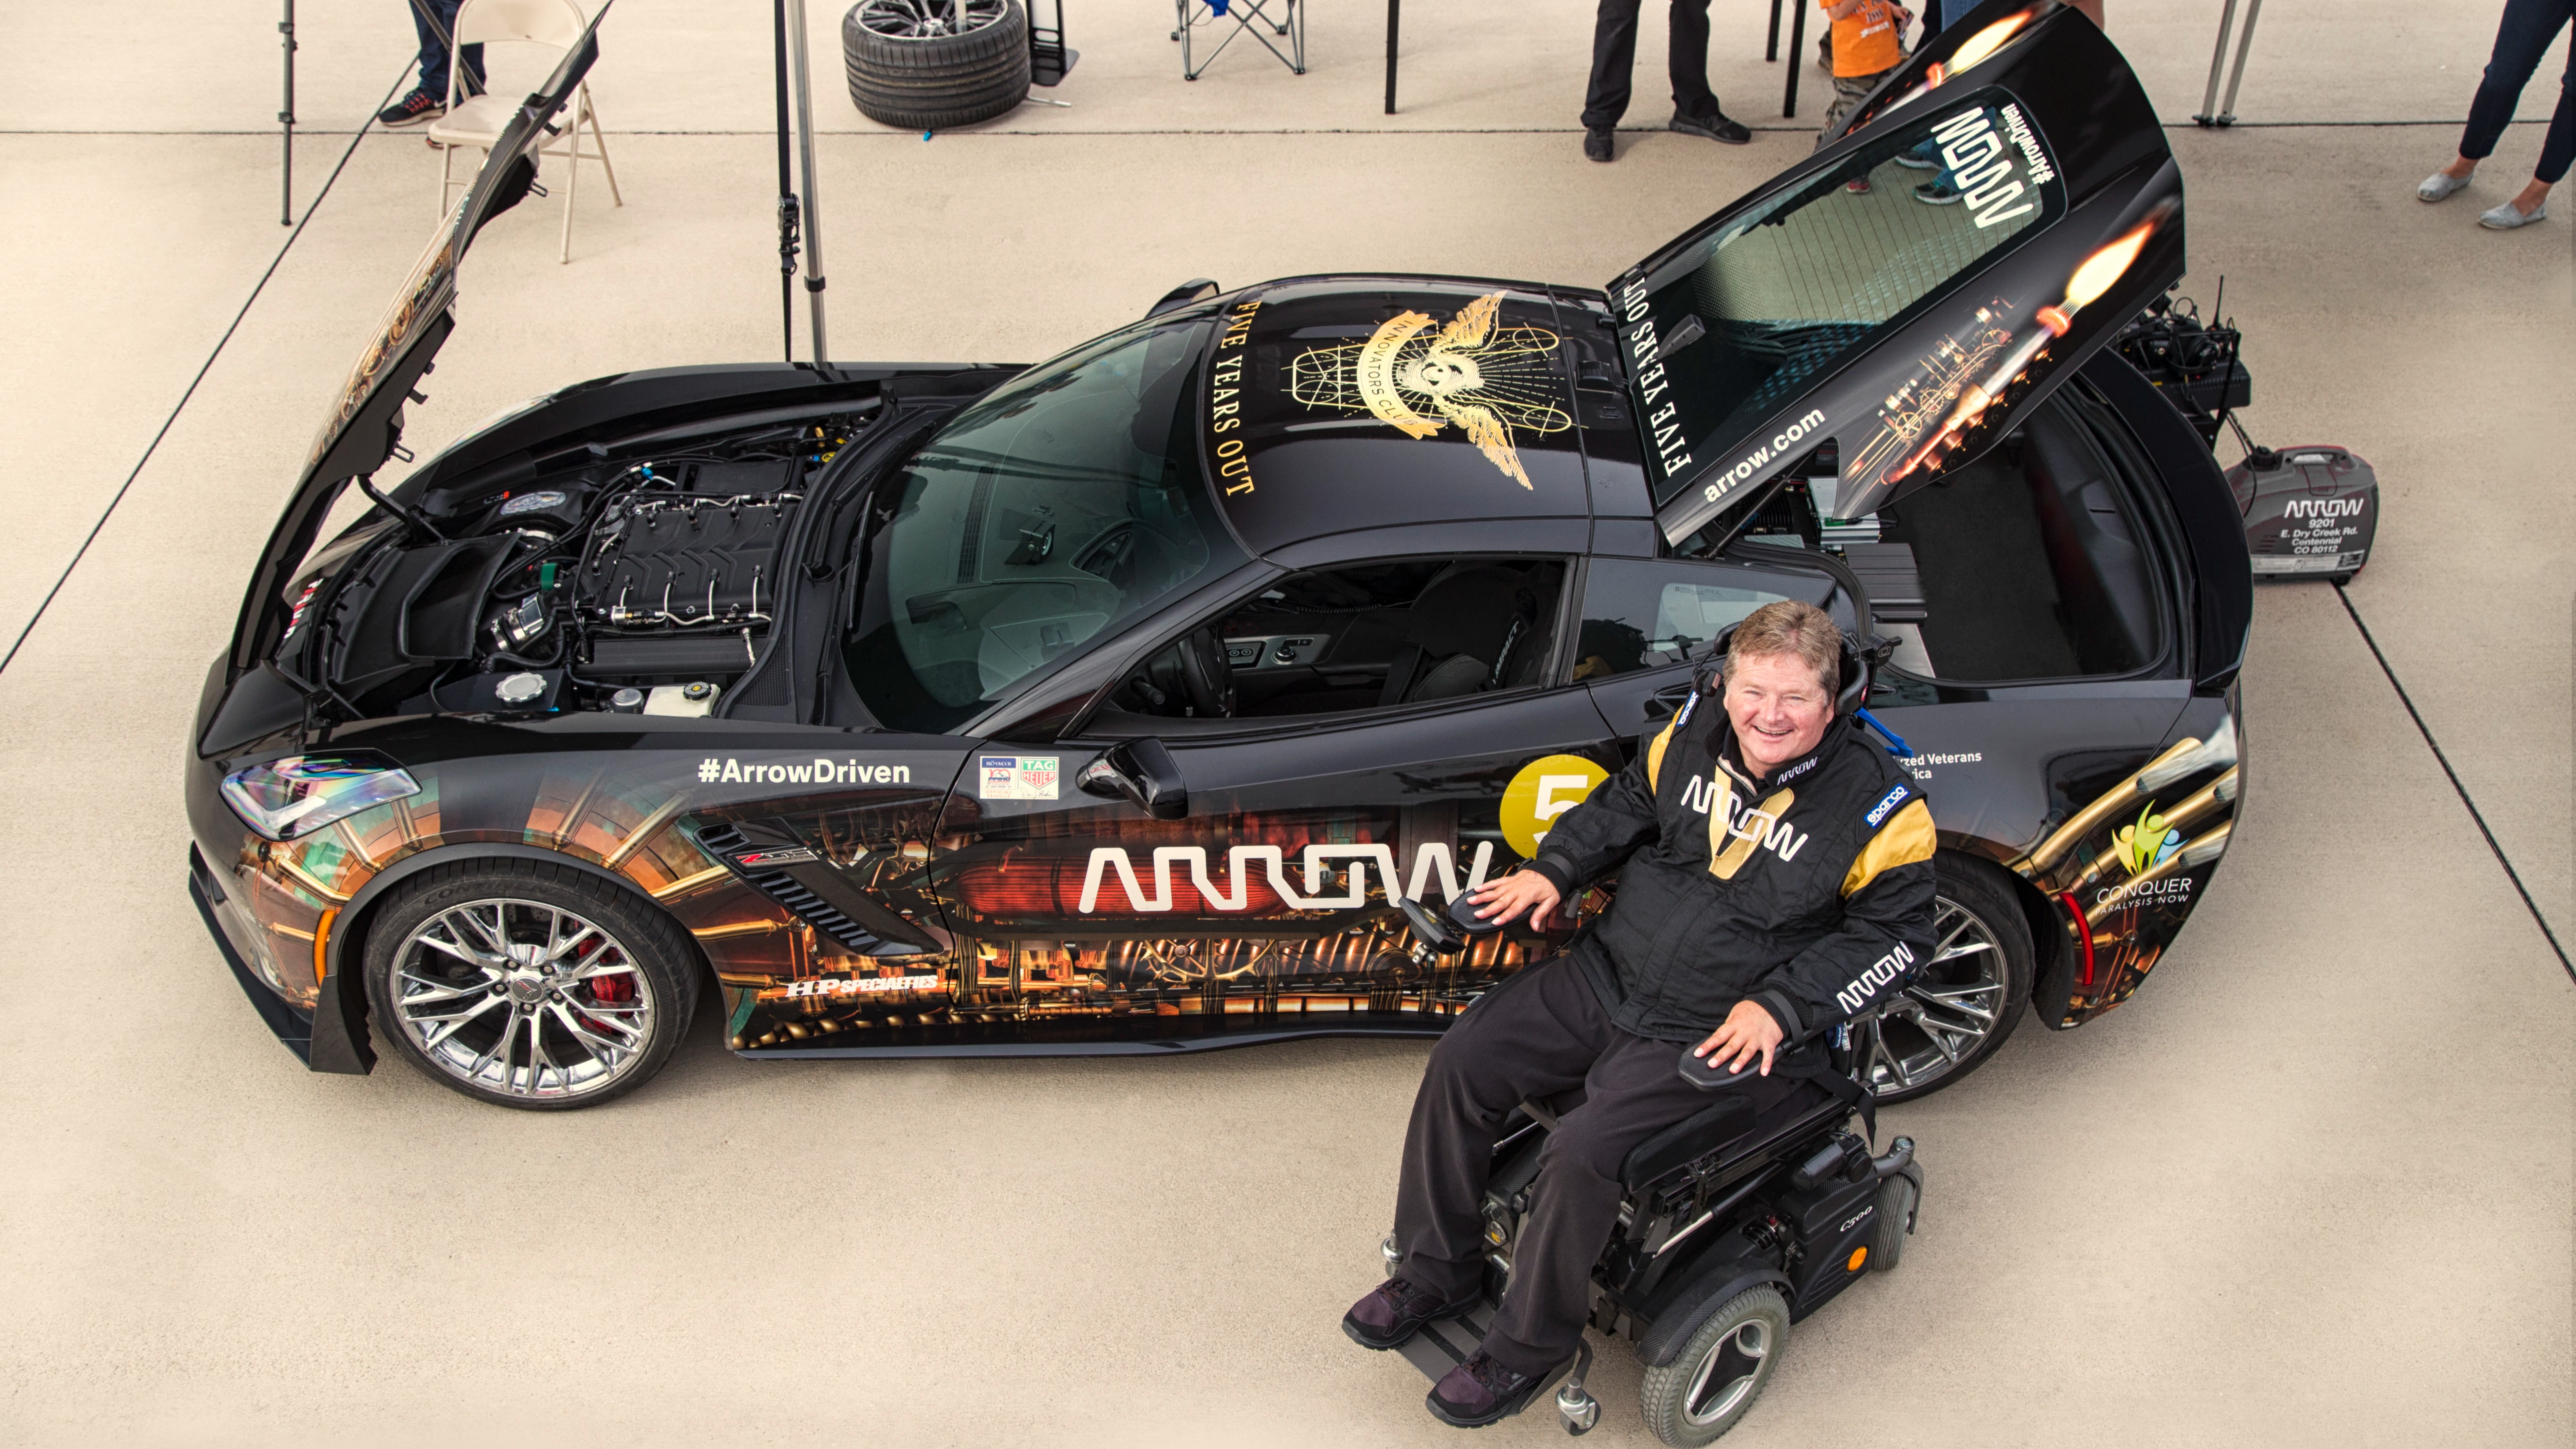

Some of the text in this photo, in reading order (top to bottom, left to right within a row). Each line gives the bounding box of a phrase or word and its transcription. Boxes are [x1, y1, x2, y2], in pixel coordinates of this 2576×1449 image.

[2001, 103, 2055, 185] #ArrowDriven
[1931, 107, 2034, 229] ARROW
[1368, 320, 1417, 426] INNOVATORS CLUB
[1624, 278, 1691, 476] FIVE YEARS OUT
[1213, 300, 1262, 497] FIVE YEARS OUT
[1704, 408, 1826, 502] arrow.com
[2285, 498, 2364, 518] ARROW
[2280, 527, 2358, 539] E. Dry Creek Rd.
[2309, 518, 2335, 529] 9201
[2292, 537, 2342, 547] Centennial
[2311, 545, 2337, 554] 80112
[698, 758, 910, 783] #ArrowDriven
[1024, 760, 1055, 770] TAG
[1777, 757, 1818, 785] ARROW
[1927, 752, 1982, 765] Veterans
[1023, 772, 1055, 787] HEUER
[1533, 775, 1588, 845] 5
[1681, 775, 1808, 861] ARROW
[1867, 786, 1908, 826] sparco
[1078, 841, 1493, 913] ARROW
[2097, 878, 2192, 904] CONQUER
[2094, 895, 2189, 915] PARALYSIS NOW
[785, 975, 938, 997] HP SPECIALTIES
[1837, 942, 1914, 1014] ARROW
[1840, 1206, 1873, 1232] C500
